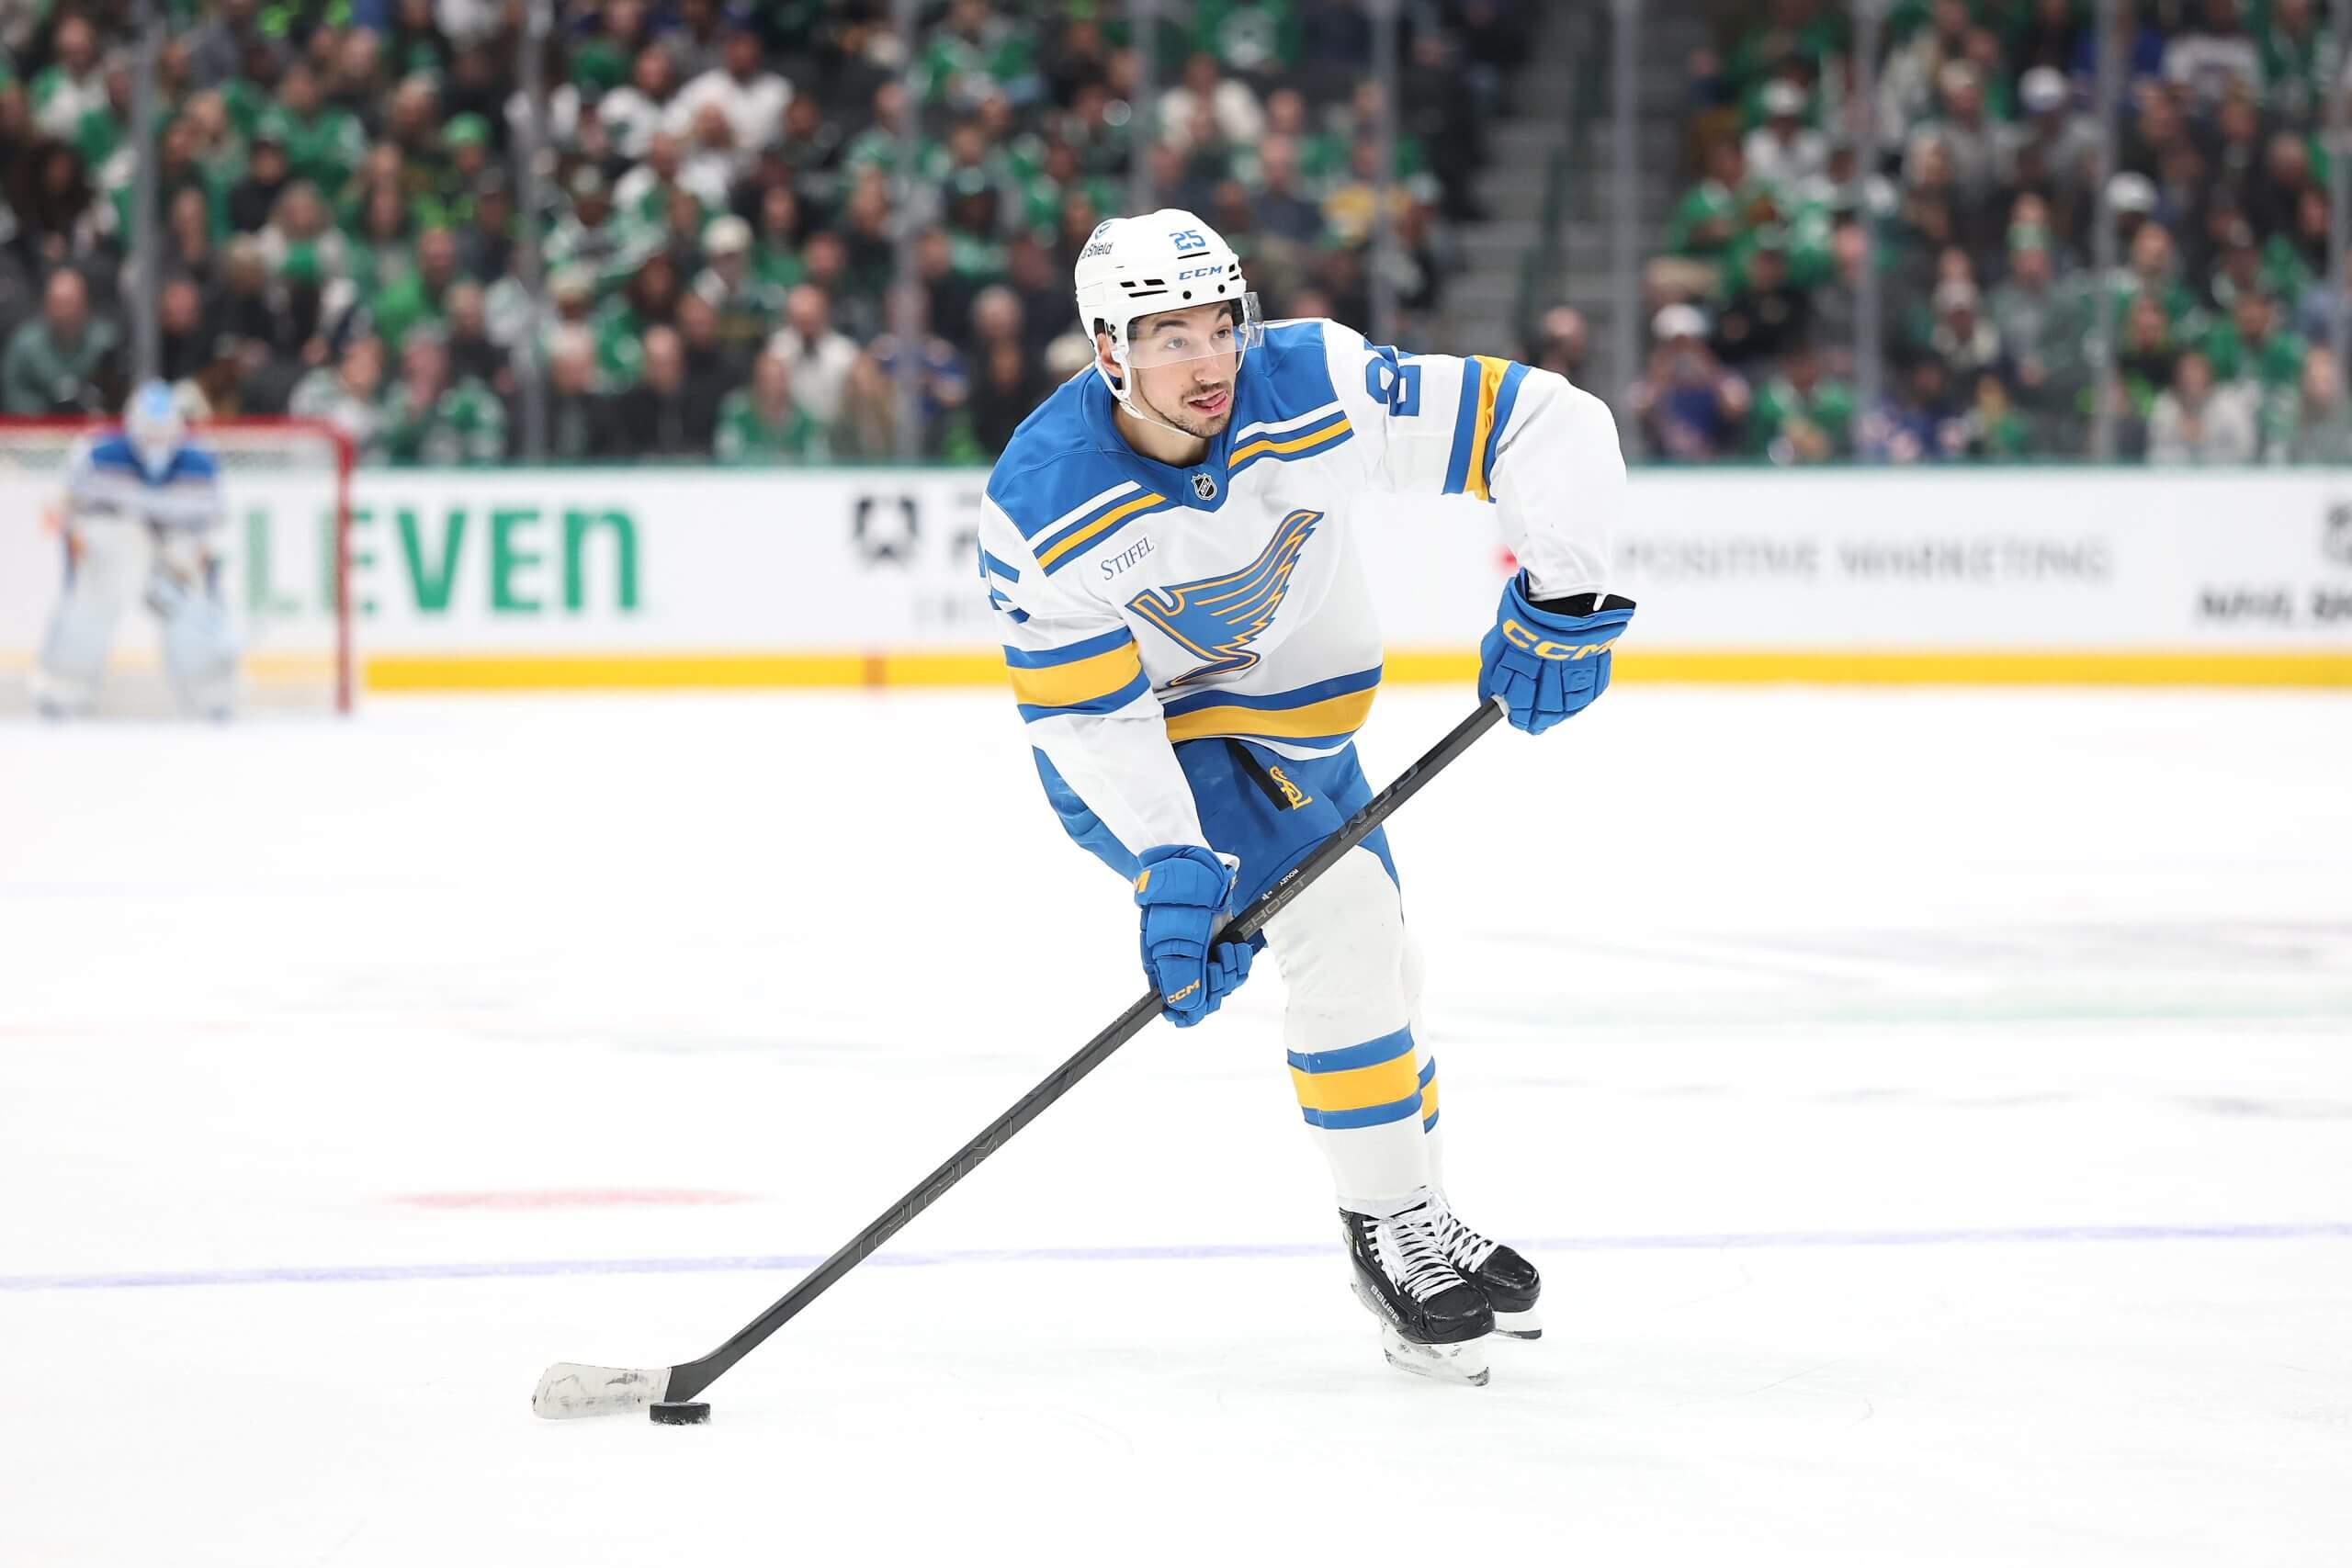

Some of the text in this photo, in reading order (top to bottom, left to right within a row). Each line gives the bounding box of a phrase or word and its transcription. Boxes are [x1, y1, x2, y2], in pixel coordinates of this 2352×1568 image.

[1169, 230, 1206, 251] 25
[1179, 265, 1223, 280] CCM
[1101, 536, 1155, 581] STIFEL
[1502, 619, 1618, 661] CCM
[1238, 874, 1306, 934] GHOST
[1167, 978, 1200, 1004] CCM
